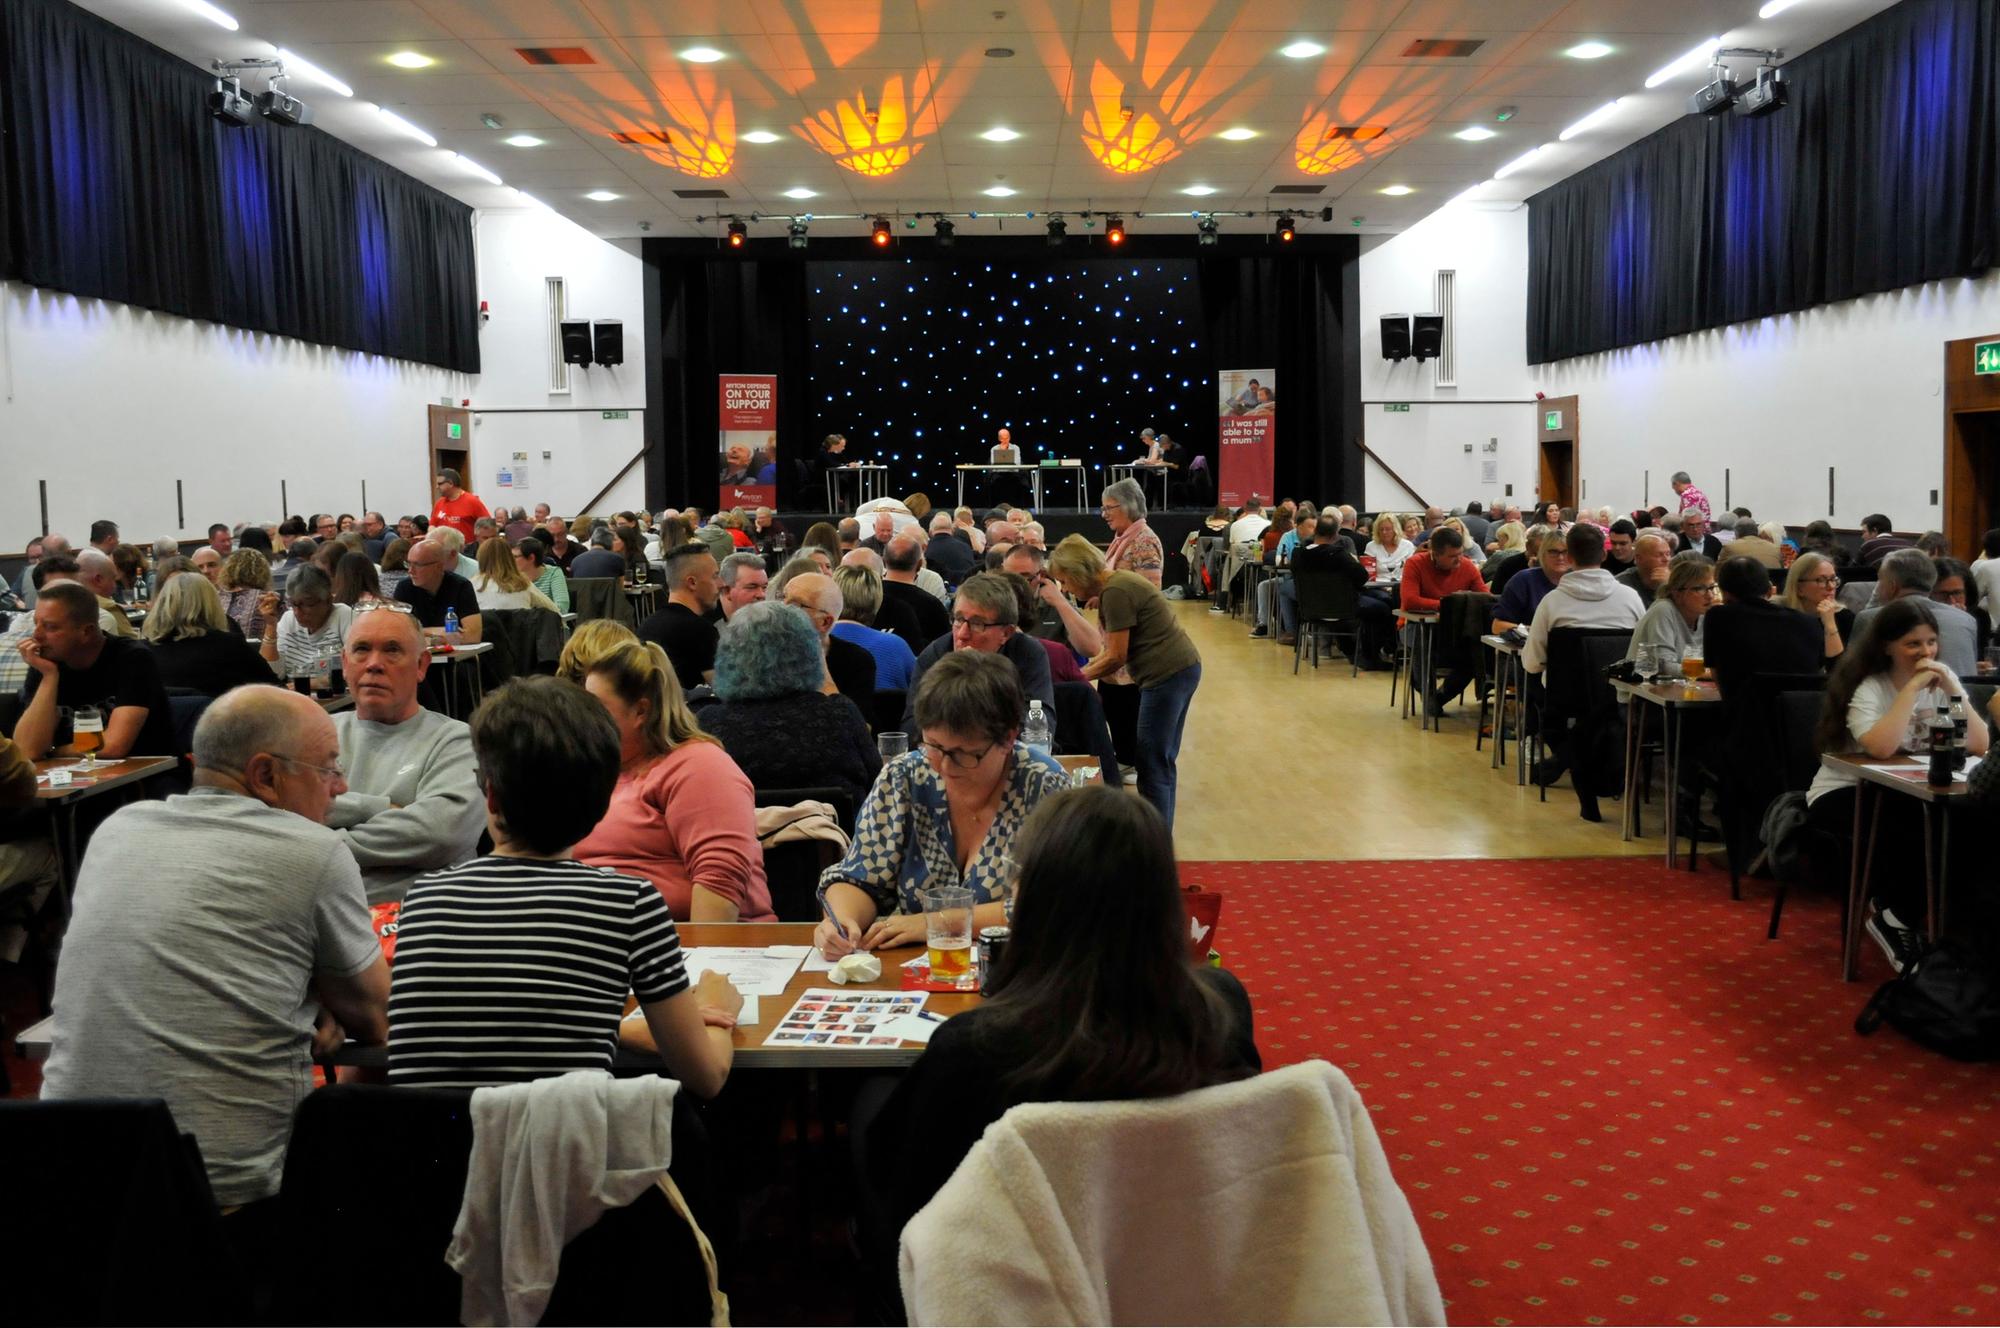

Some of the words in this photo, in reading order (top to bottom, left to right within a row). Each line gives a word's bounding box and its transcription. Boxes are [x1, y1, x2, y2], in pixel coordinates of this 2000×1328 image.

[726, 389, 742, 399] ON
[744, 389, 771, 399] YOUR
[726, 399, 771, 409] SUPPORT
[1254, 418, 1268, 427] still
[1222, 428, 1242, 436] able
[1243, 427, 1252, 436] to
[1253, 427, 1265, 436] be
